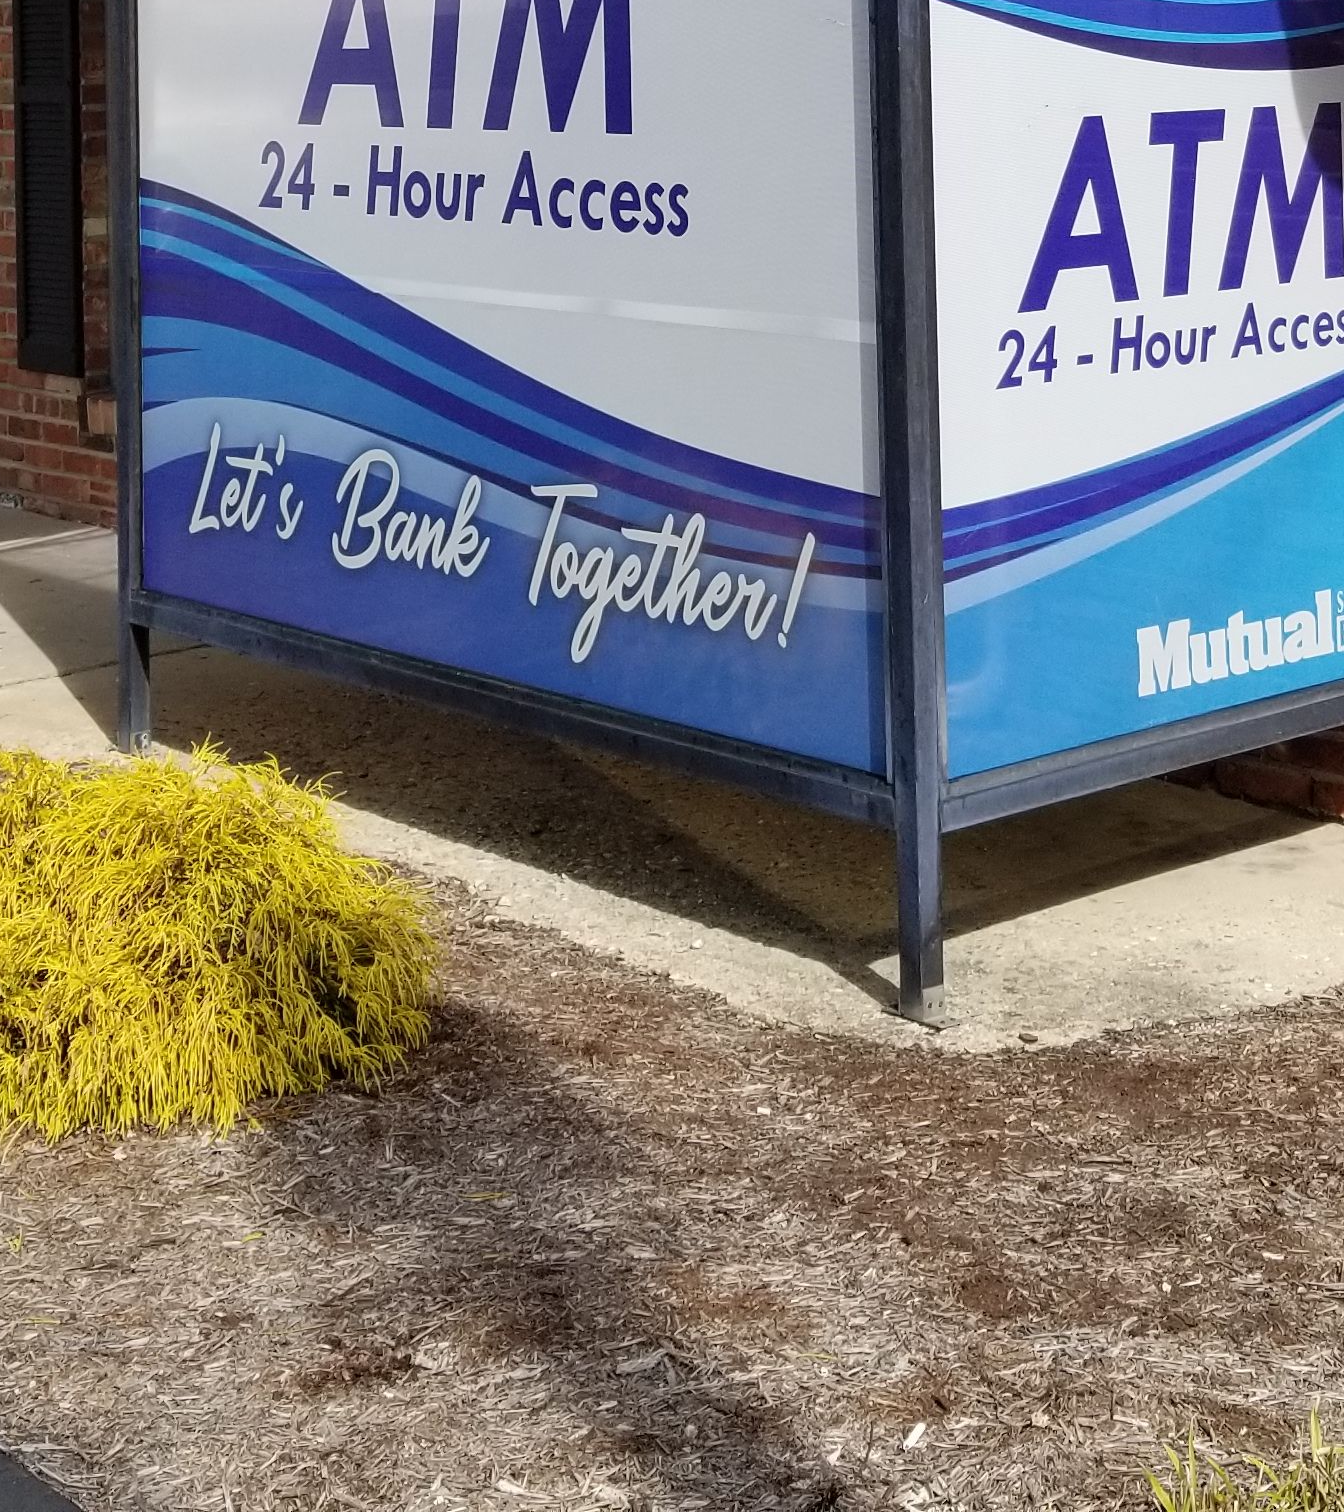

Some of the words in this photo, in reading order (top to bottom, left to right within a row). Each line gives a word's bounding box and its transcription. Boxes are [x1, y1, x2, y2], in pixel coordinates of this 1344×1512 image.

[258, 140, 315, 211] 24
[367, 145, 486, 222] Hour
[501, 150, 690, 237] Access
[996, 325, 1057, 390] 24
[1110, 315, 1216, 374] Hour
[189, 422, 303, 539] Let's
[331, 448, 490, 578] Bank
[529, 484, 815, 663] Together!
[1136, 589, 1334, 697] Mutual
